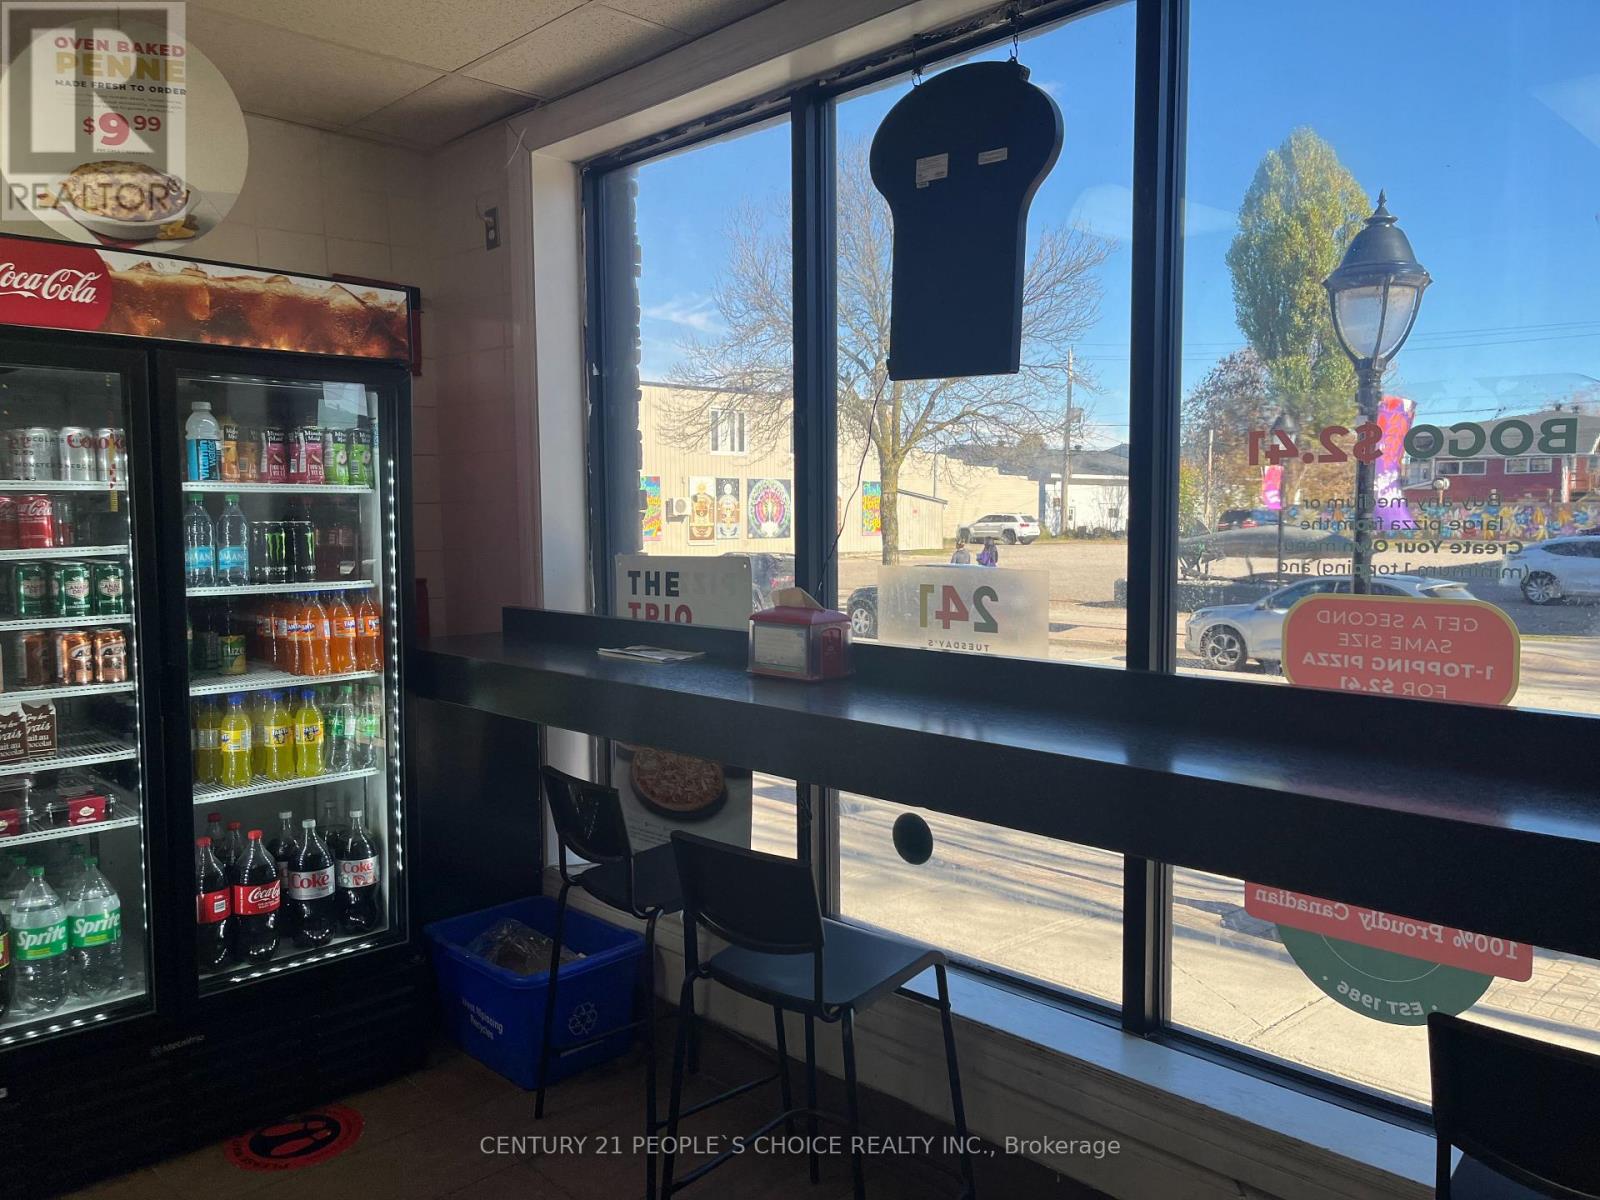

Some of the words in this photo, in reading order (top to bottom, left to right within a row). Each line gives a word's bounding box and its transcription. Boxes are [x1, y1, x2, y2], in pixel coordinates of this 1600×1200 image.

[55, 37, 109, 51] OVEN
[117, 41, 185, 57] BAKED
[56, 52, 185, 83] PENNE
[55, 80, 87, 88] MADE
[91, 82, 126, 90] FRESH
[130, 84, 145, 92] TO
[149, 86, 187, 95] ORDER
[628, 571, 680, 597] THE
[628, 602, 692, 624] TRIO
[343, 861, 373, 874] Coke
[291, 872, 330, 889] Coke
[73, 912, 121, 938] Sprite
[17, 924, 66, 950] Sprite
